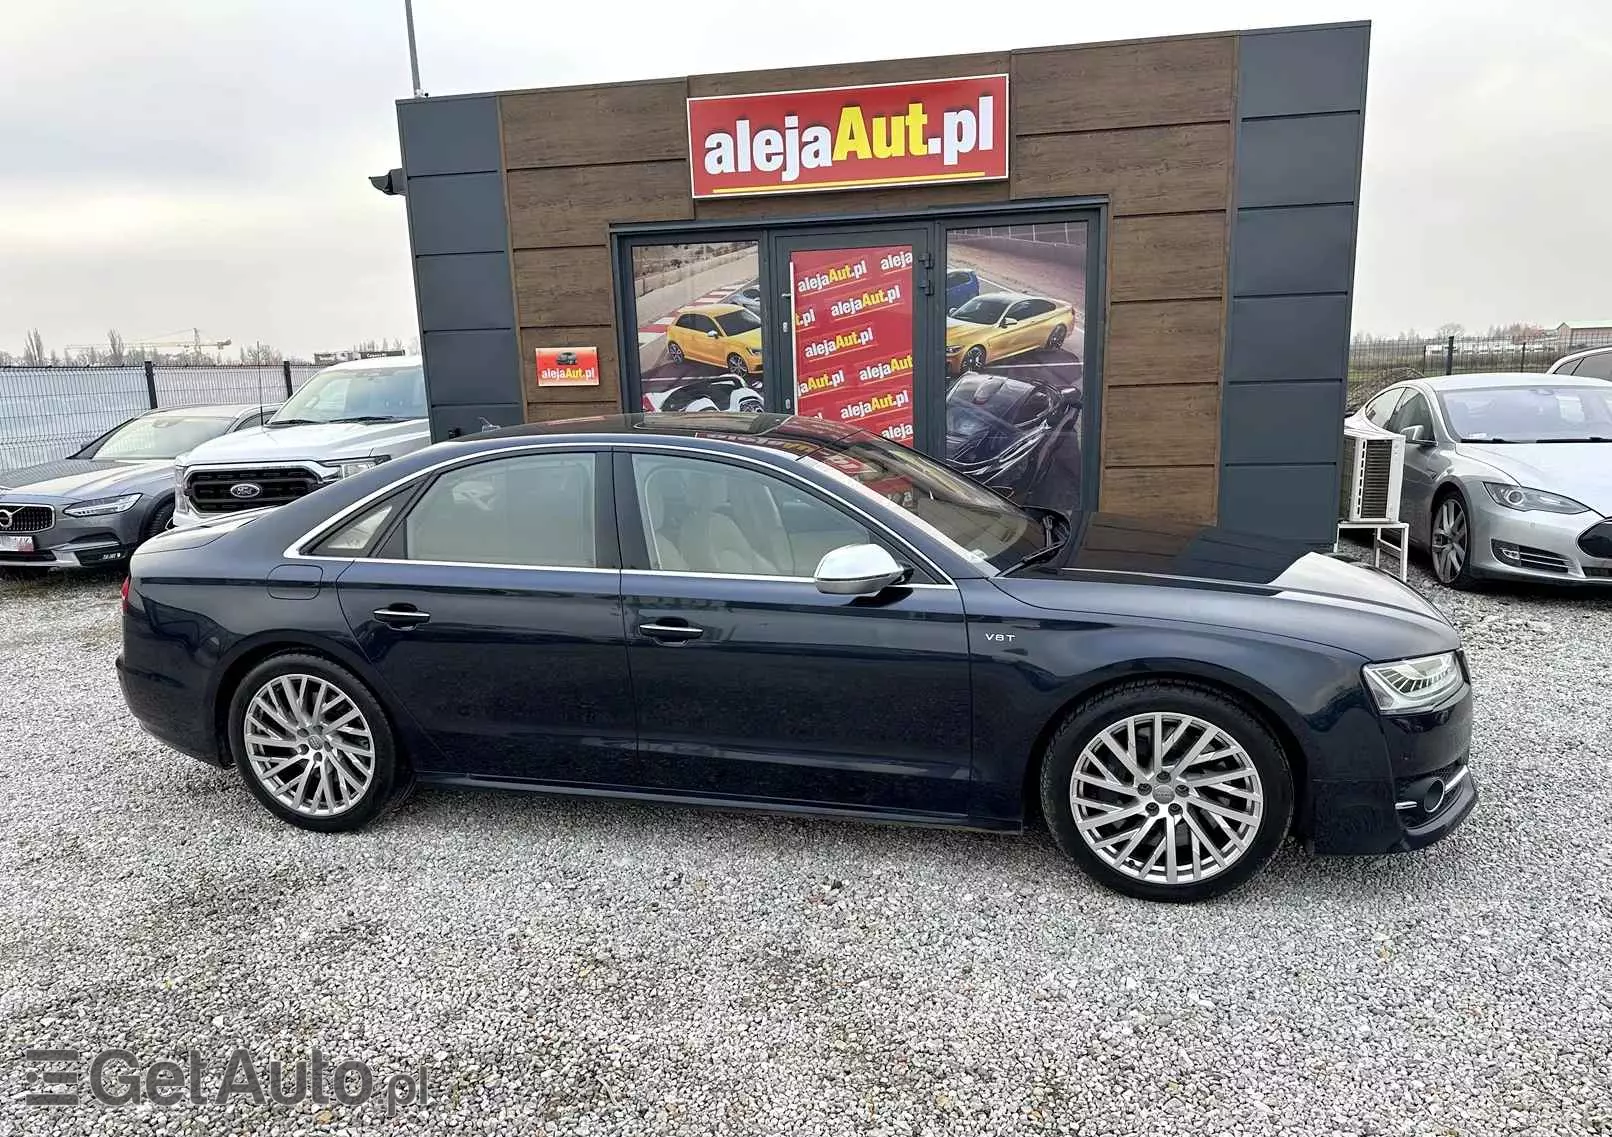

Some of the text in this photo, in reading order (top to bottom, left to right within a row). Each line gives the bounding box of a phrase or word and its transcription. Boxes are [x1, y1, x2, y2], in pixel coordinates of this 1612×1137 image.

[704, 95, 993, 182] alejaAut.pl
[798, 260, 867, 292] alejaAut.pl
[830, 285, 900, 317] alejaAut.pl
[804, 327, 873, 358] alejaAut.pl
[542, 367, 595, 381] alejaAut.pl
[840, 389, 909, 419] alejaAut.pl
